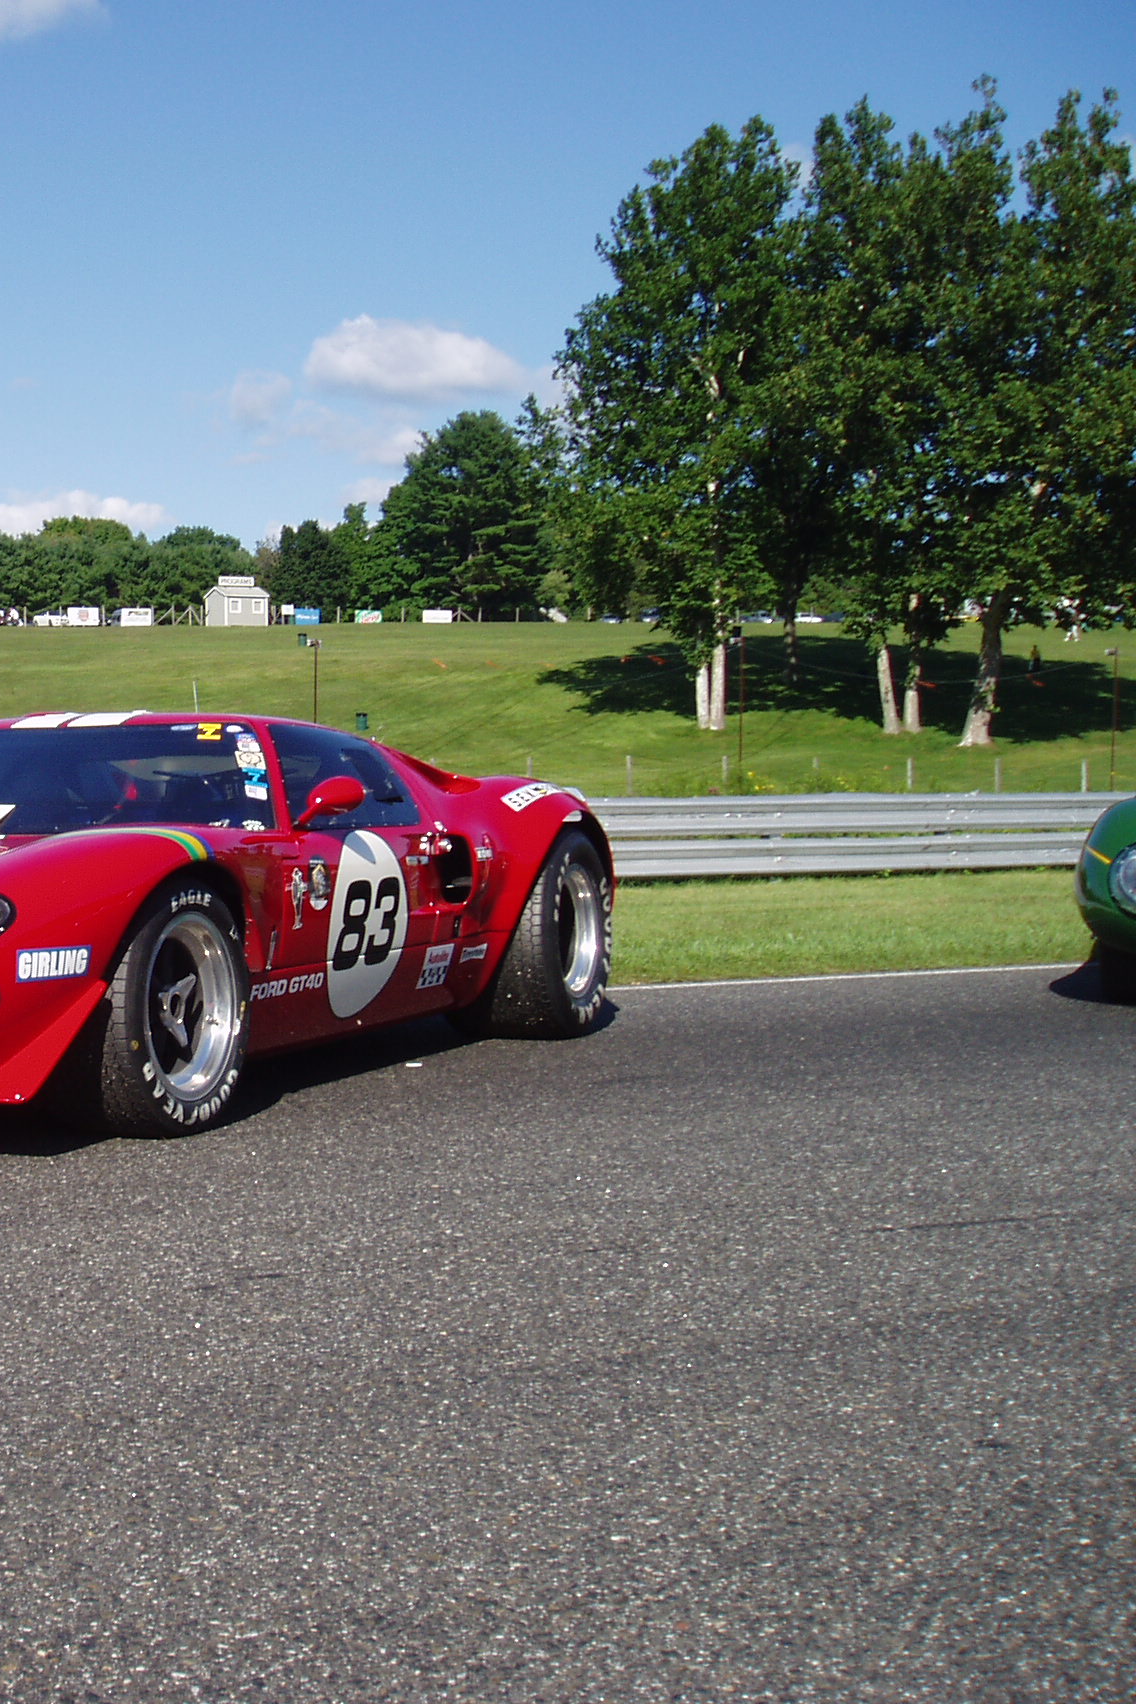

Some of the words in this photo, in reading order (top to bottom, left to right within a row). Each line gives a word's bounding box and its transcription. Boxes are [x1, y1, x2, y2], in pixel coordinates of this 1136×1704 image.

[171, 888, 213, 912] EAGLE
[332, 877, 400, 971] 83
[18, 948, 88, 978] GIRLING
[250, 979, 288, 1001] FORD
[288, 972, 325, 994] GT40
[141, 1060, 240, 1126] GOODYEAR
